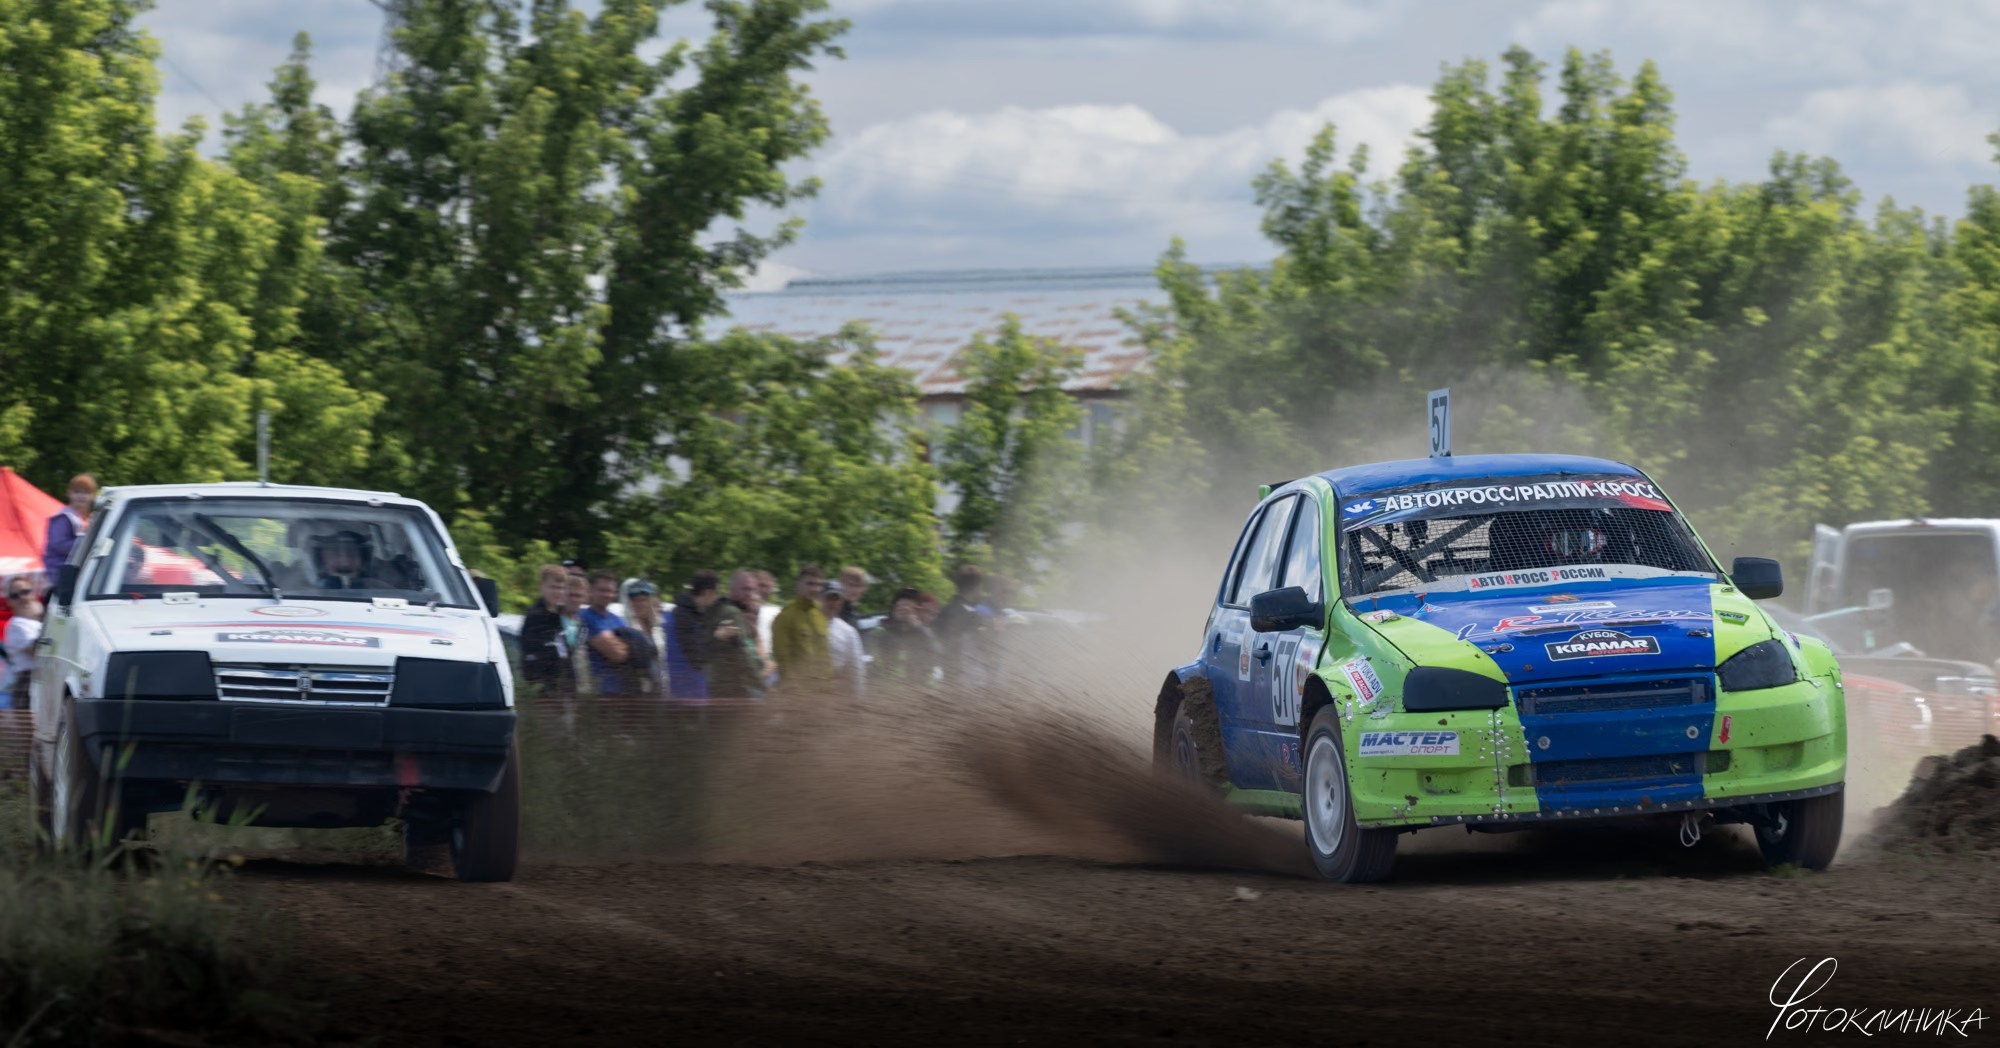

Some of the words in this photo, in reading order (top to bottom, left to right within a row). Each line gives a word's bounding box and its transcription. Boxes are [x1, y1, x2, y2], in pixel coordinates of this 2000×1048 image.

[1432, 395, 1448, 452] 57
[1551, 567, 1606, 581] РОССИИ
[227, 633, 368, 645] KRAMAR
[1580, 631, 1618, 641] КУБОК
[1555, 639, 1649, 654] KRAMAR
[1274, 640, 1298, 718] 57
[1361, 731, 1458, 747] МАСТЕР
[1410, 745, 1452, 754] СПОРТ
